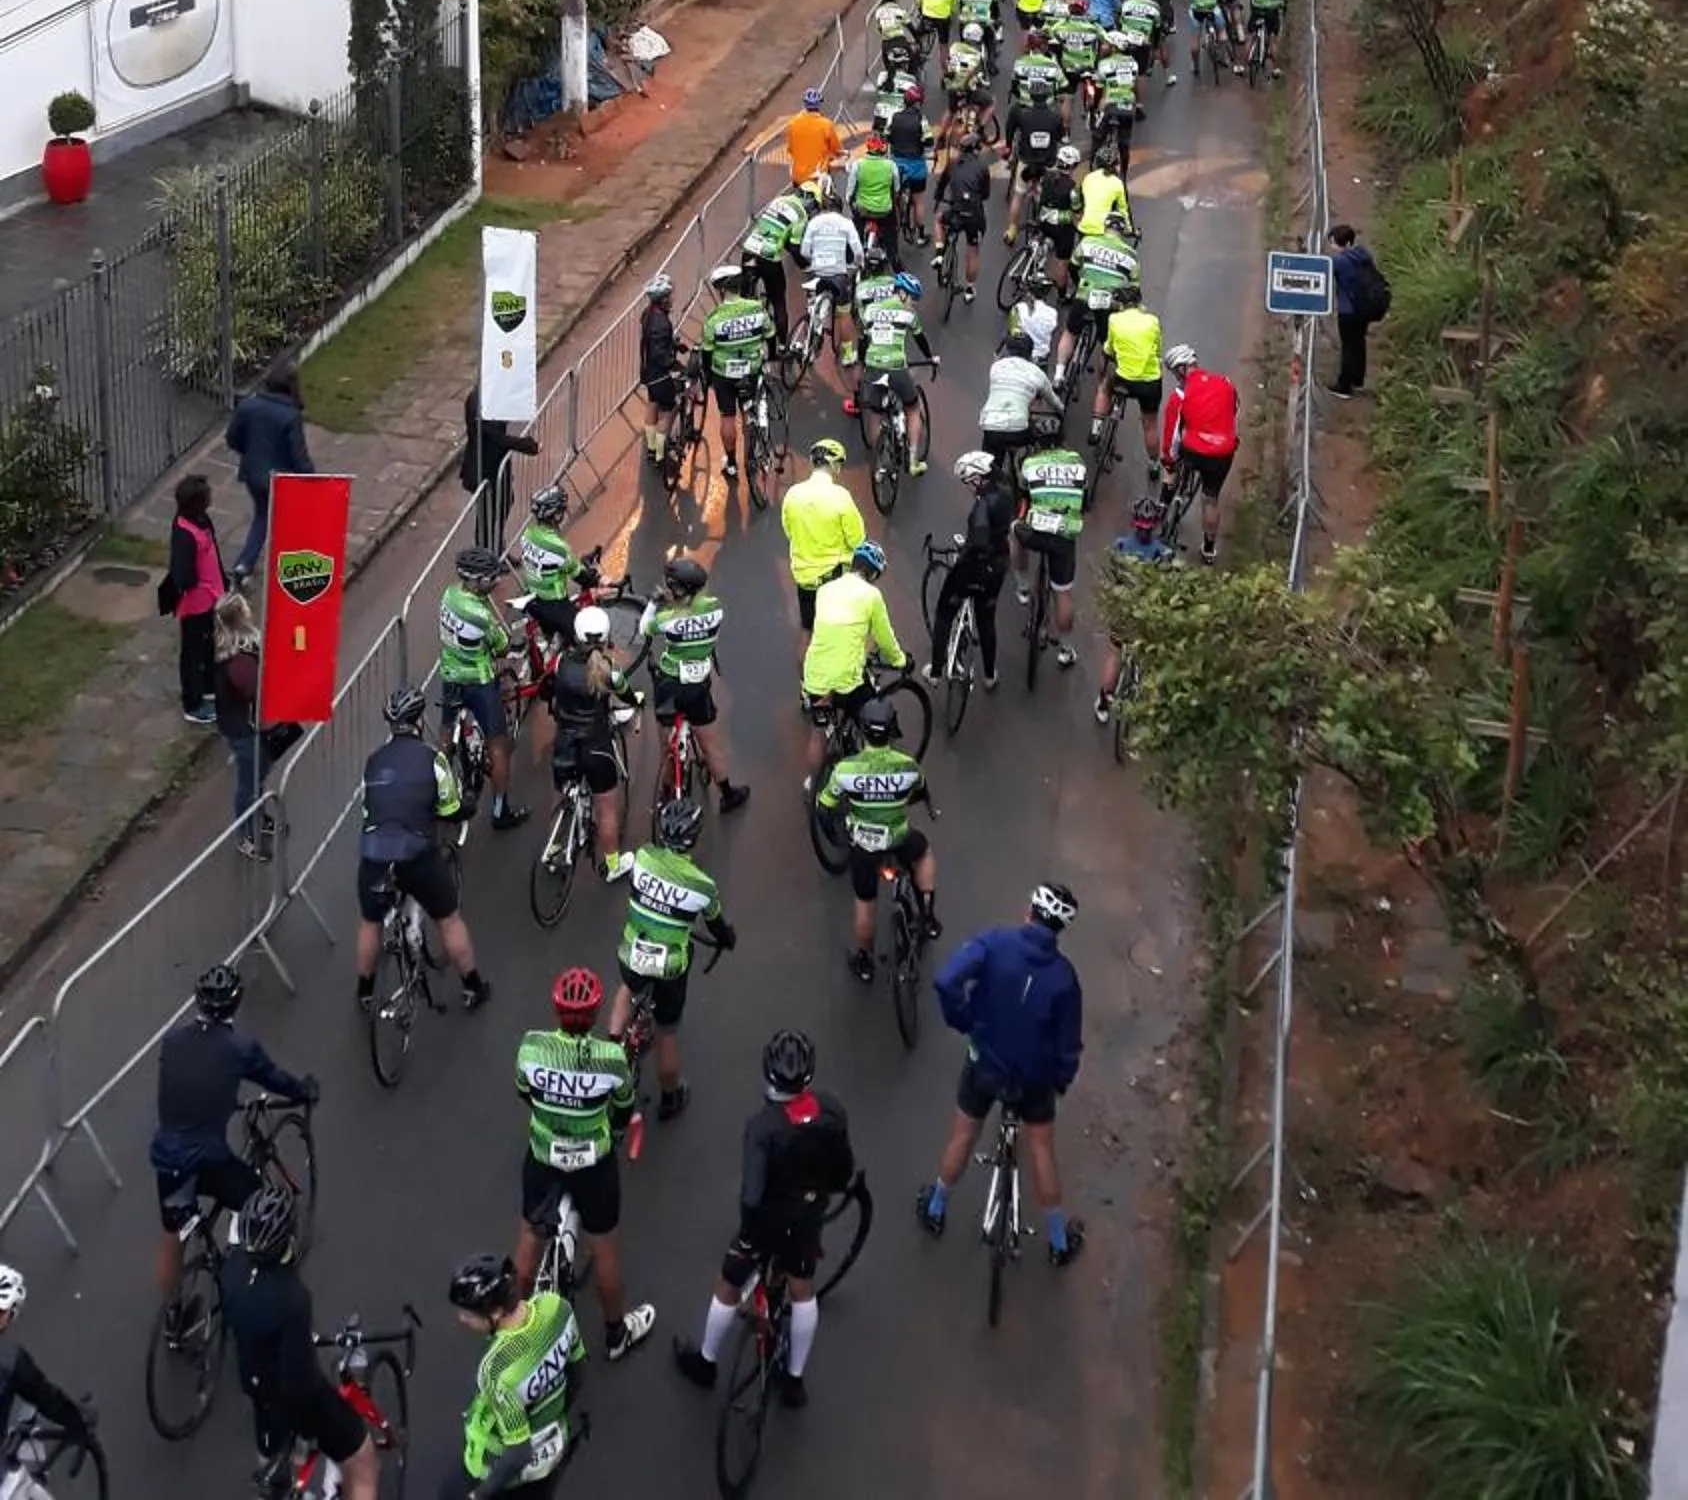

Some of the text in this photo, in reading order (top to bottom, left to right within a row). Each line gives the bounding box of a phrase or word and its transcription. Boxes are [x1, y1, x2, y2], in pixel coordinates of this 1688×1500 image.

[1035, 466, 1079, 480] GFNY
[673, 613, 716, 634] GFNY
[853, 775, 905, 793] GFNY
[638, 872, 688, 906] GFNY
[533, 1067, 597, 1096] GFNY
[543, 1092, 583, 1108] BRASIL
